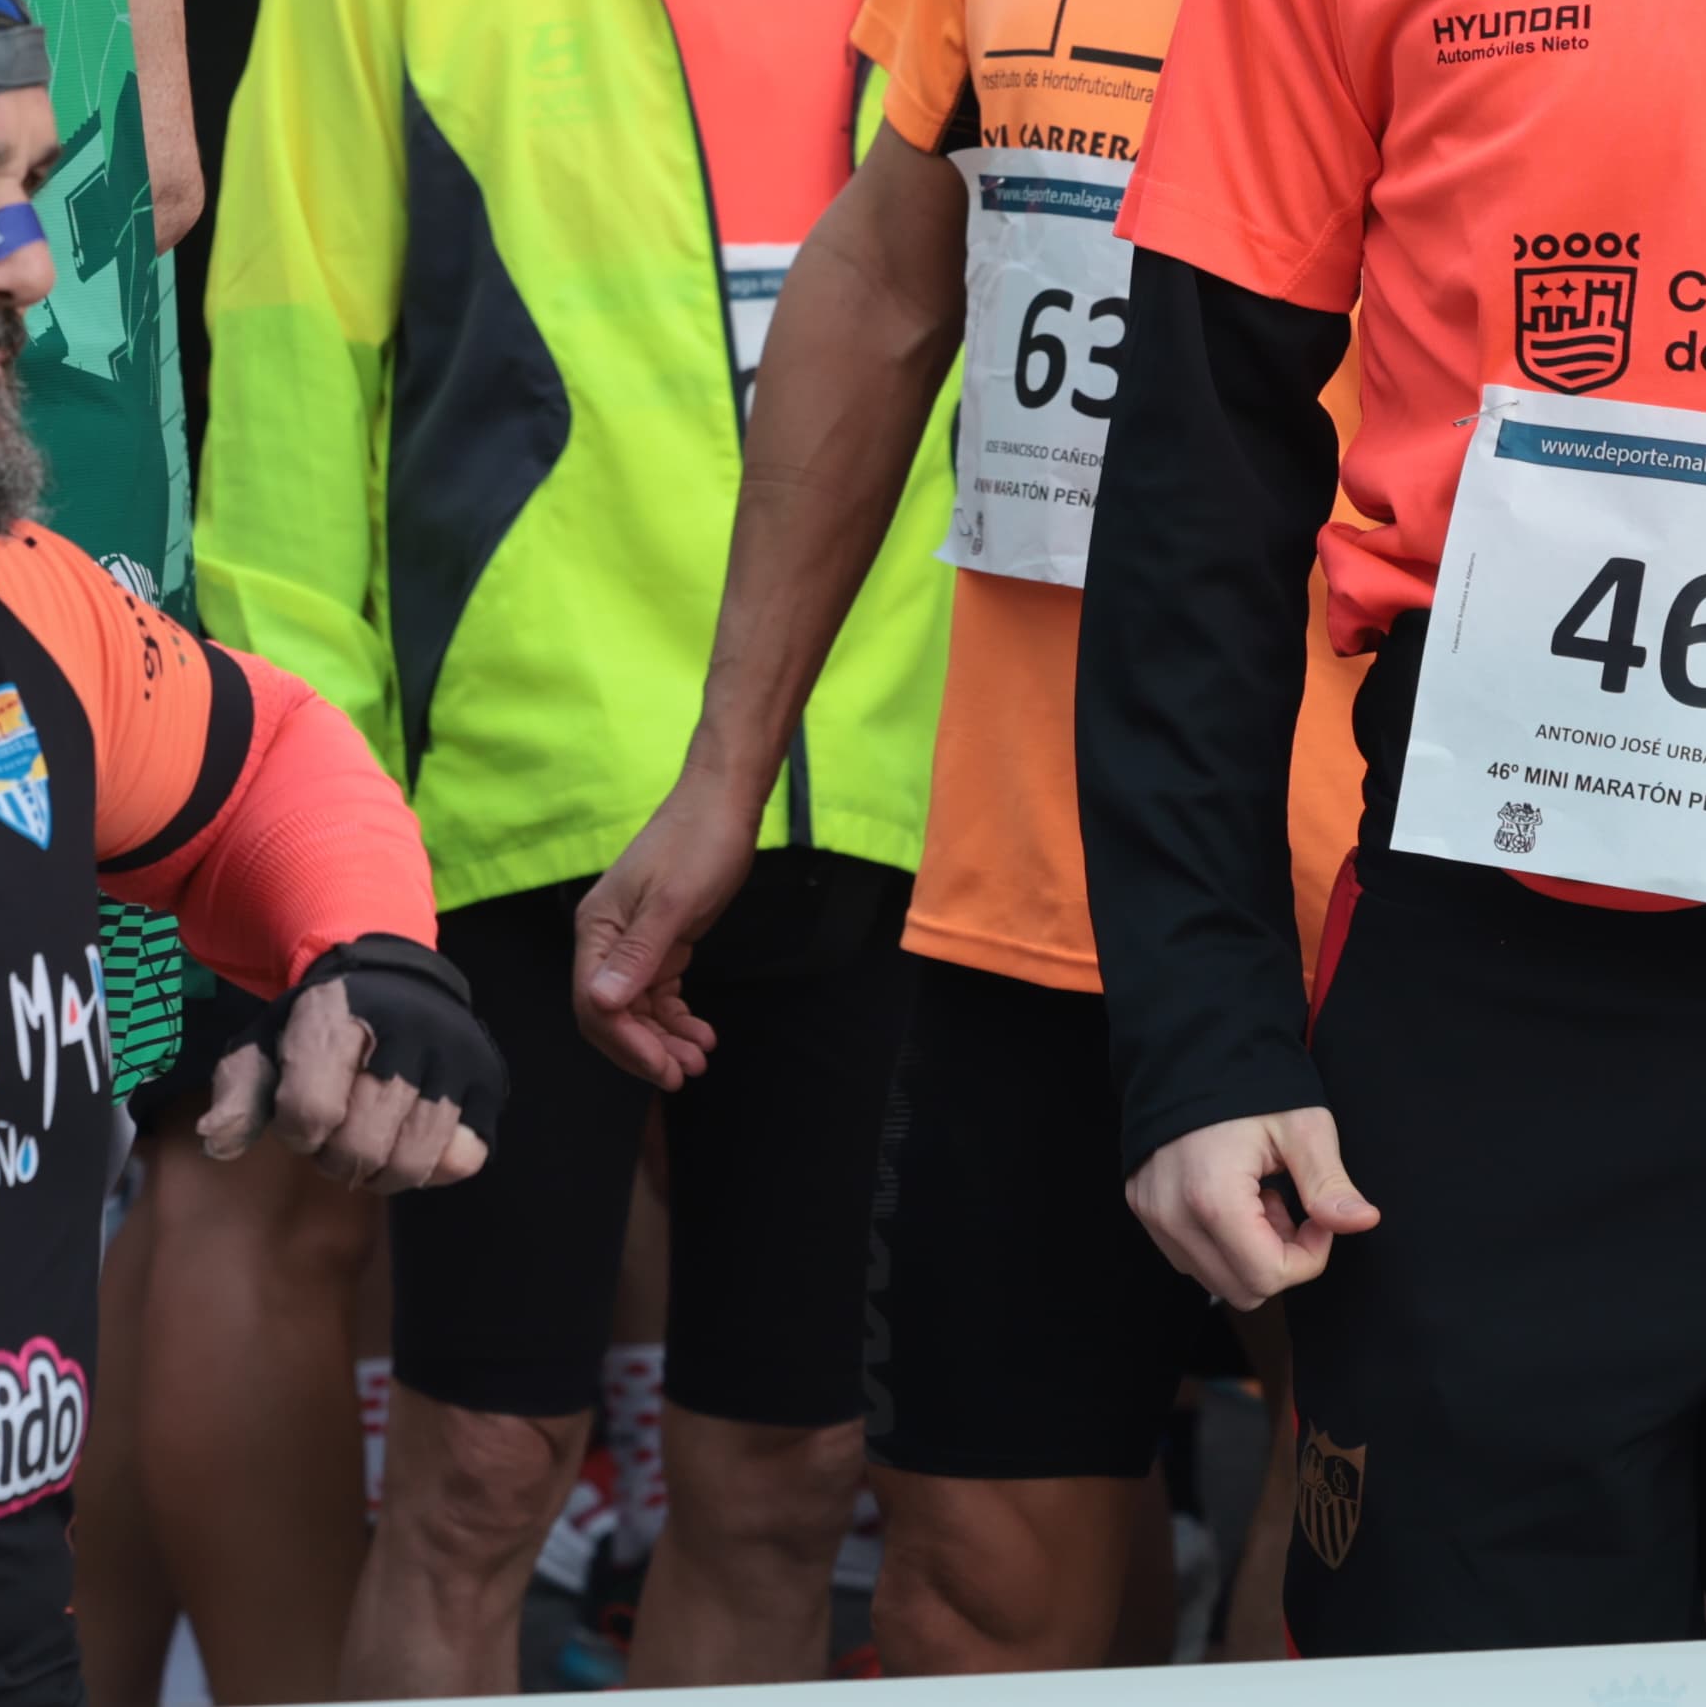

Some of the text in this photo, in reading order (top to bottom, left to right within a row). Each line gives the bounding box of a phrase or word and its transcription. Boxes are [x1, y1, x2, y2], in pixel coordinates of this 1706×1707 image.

[1432, 4, 1592, 45] HYUNDAI
[1436, 36, 1590, 66] Automóviles Nieto
[1534, 723, 1617, 750] ANTONIO
[1619, 736, 1663, 757] JOSÉ
[1523, 765, 1570, 790] MINI
[1573, 772, 1683, 808] MARATÓN
